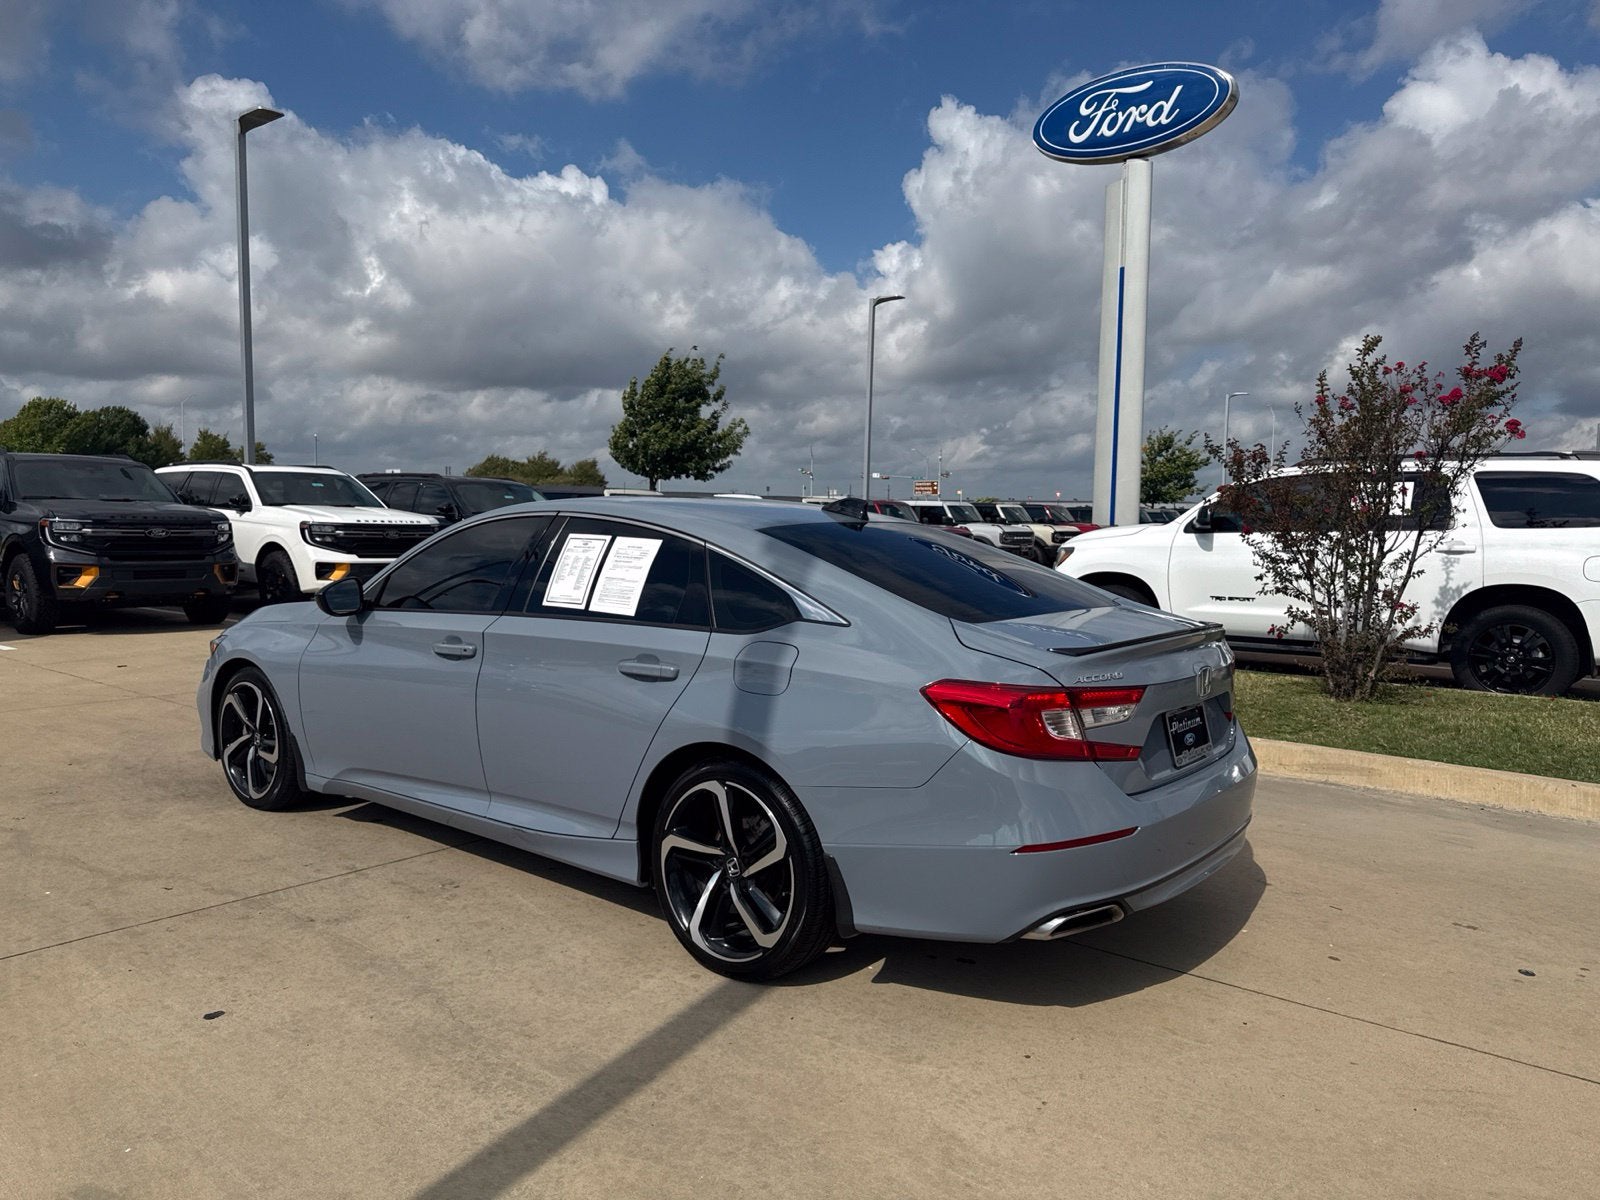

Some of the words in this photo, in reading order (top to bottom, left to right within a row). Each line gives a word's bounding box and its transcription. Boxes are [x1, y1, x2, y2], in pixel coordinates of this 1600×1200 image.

[1068, 80, 1184, 144] Ford
[1072, 671, 1125, 684] ACCORD
[1170, 717, 1203, 734] Platinum
